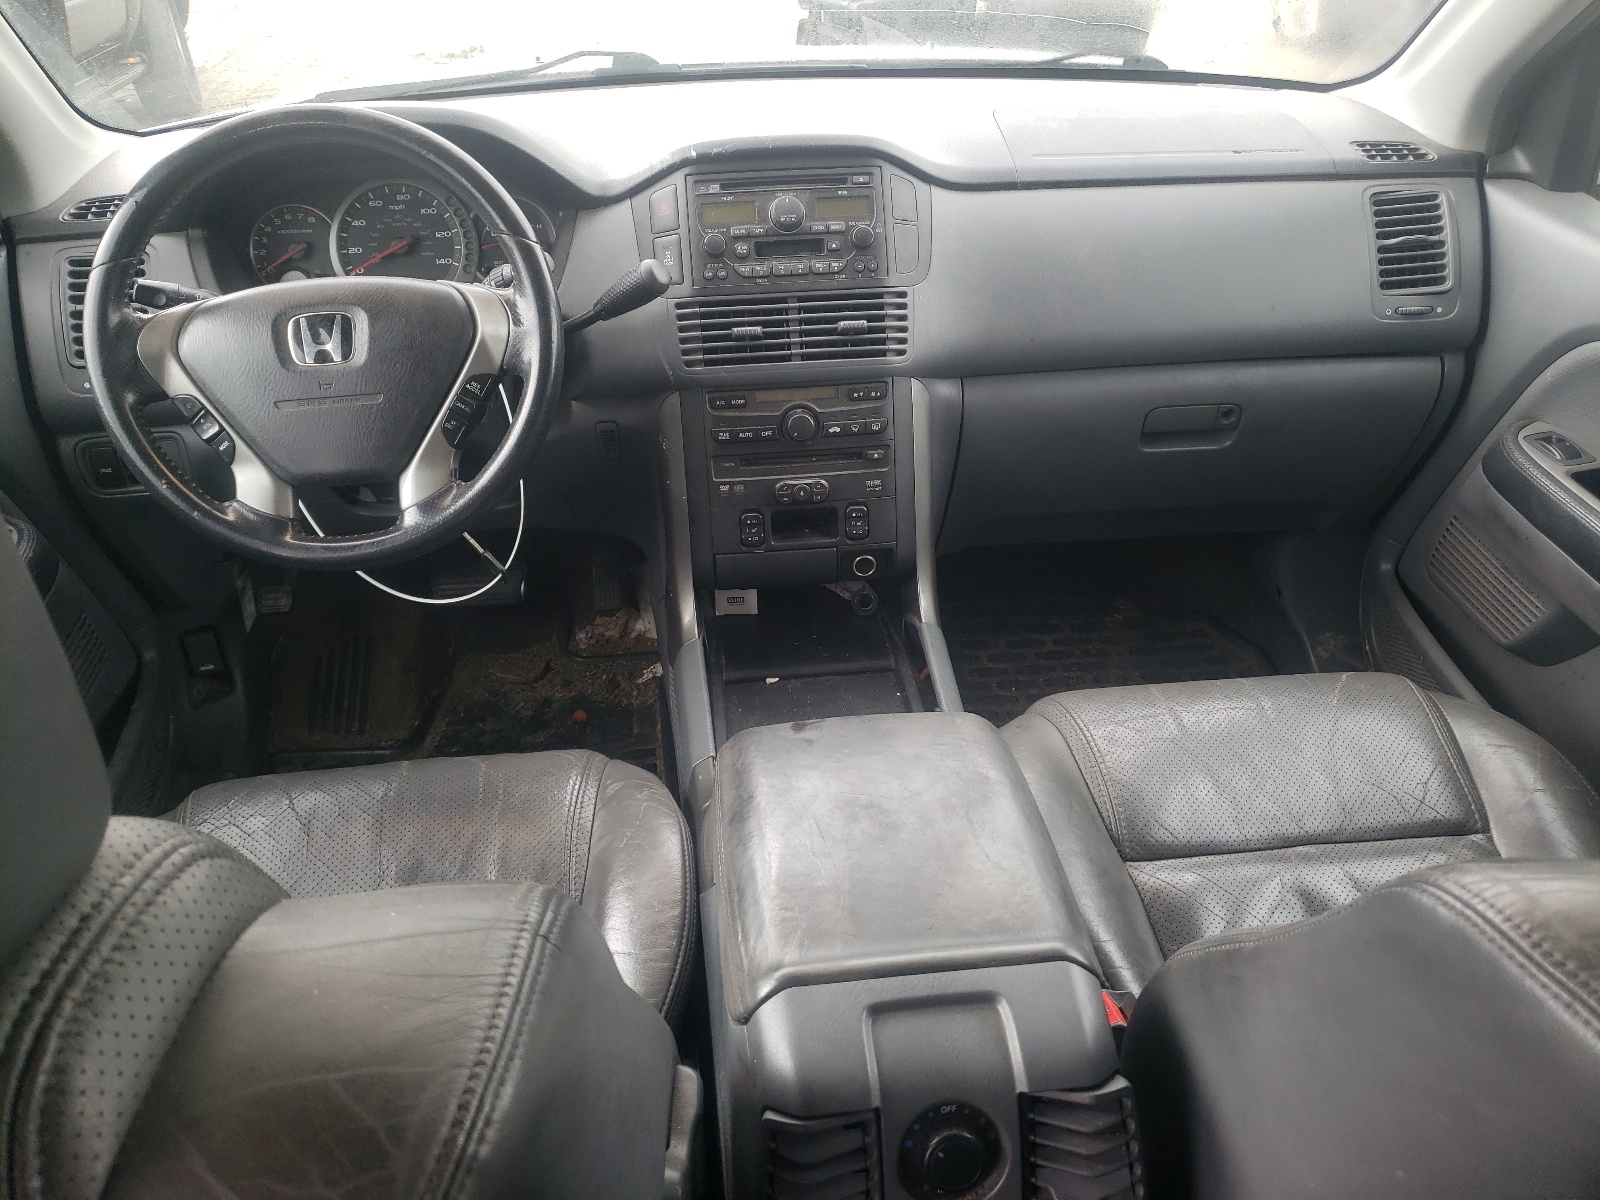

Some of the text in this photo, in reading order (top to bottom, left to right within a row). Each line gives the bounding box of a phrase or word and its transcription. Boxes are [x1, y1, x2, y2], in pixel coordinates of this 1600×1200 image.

[420, 207, 437, 215] 100
[348, 246, 363, 254] 20
[435, 257, 452, 265] 140
[941, 1105, 957, 1113] OFF
